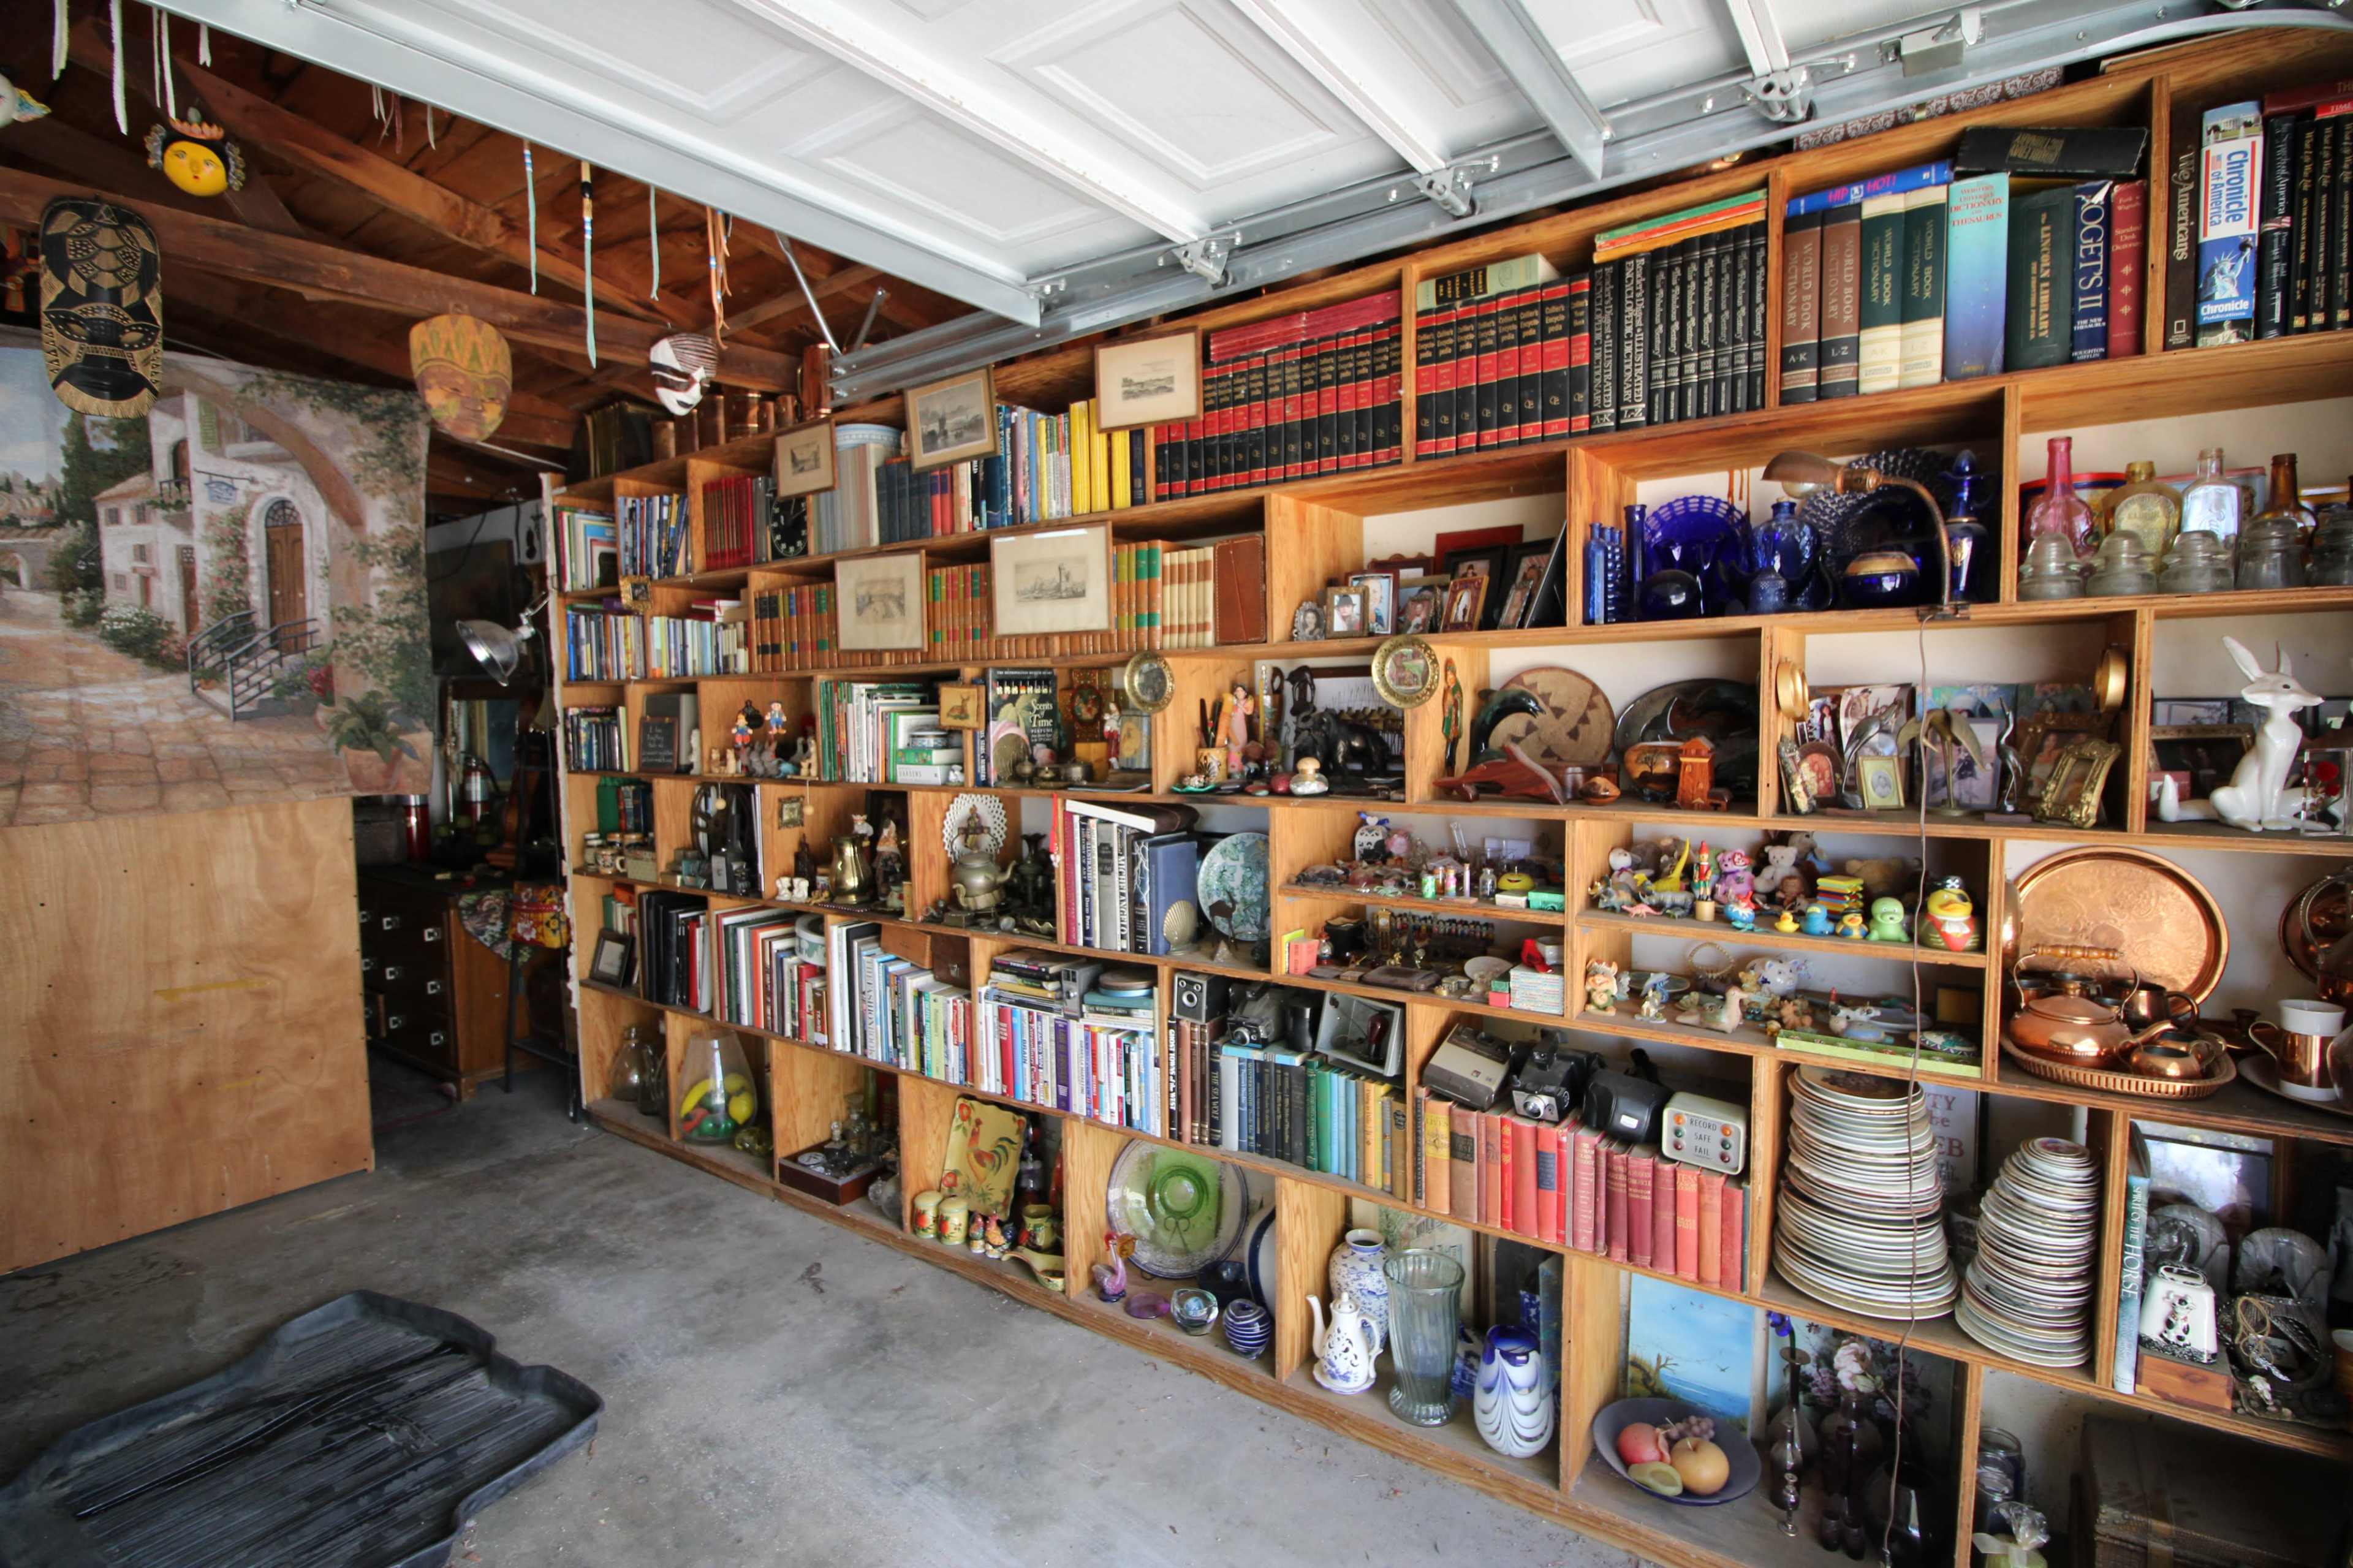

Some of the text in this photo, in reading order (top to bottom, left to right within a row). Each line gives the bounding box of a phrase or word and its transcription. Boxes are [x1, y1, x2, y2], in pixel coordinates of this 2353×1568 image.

[1951, 198, 2003, 212] DICTIONARY
[2209, 171, 2224, 227] of America
[2225, 150, 2249, 223] Chronicle
[1952, 213, 2003, 226] THESAURUS
[2040, 225, 2051, 278] LINCOLN
[1786, 252, 1798, 327] DICTIONARY
[1802, 243, 1813, 330] WORLD BOOK
[1828, 246, 1839, 320] DICTIONARY
[1843, 238, 1854, 323] WORLD BOOK
[2200, 299, 2249, 316] Chronicle
[1623, 260, 1634, 403] ENCYCLOPEDIC DICTIONARY
[1631, 259, 1645, 402] Reader's Digest ILLUSTRATED
[2039, 282, 2049, 338] LIBRARY
[1593, 347, 1602, 408] DICTIONARY
[1030, 699, 1053, 714] Scents
[1030, 714, 1053, 727] Time
[1118, 856, 1127, 934] MICHELANGELO
[866, 981, 875, 1027] FASHION
[1038, 1043, 1042, 1053] TO
[1690, 1118, 1716, 1131] RECORD
[1694, 1132, 1711, 1143] SAFE
[1695, 1146, 1710, 1156] FAIL
[2120, 1186, 2143, 1300] SPIRIT OF THE HORSE
